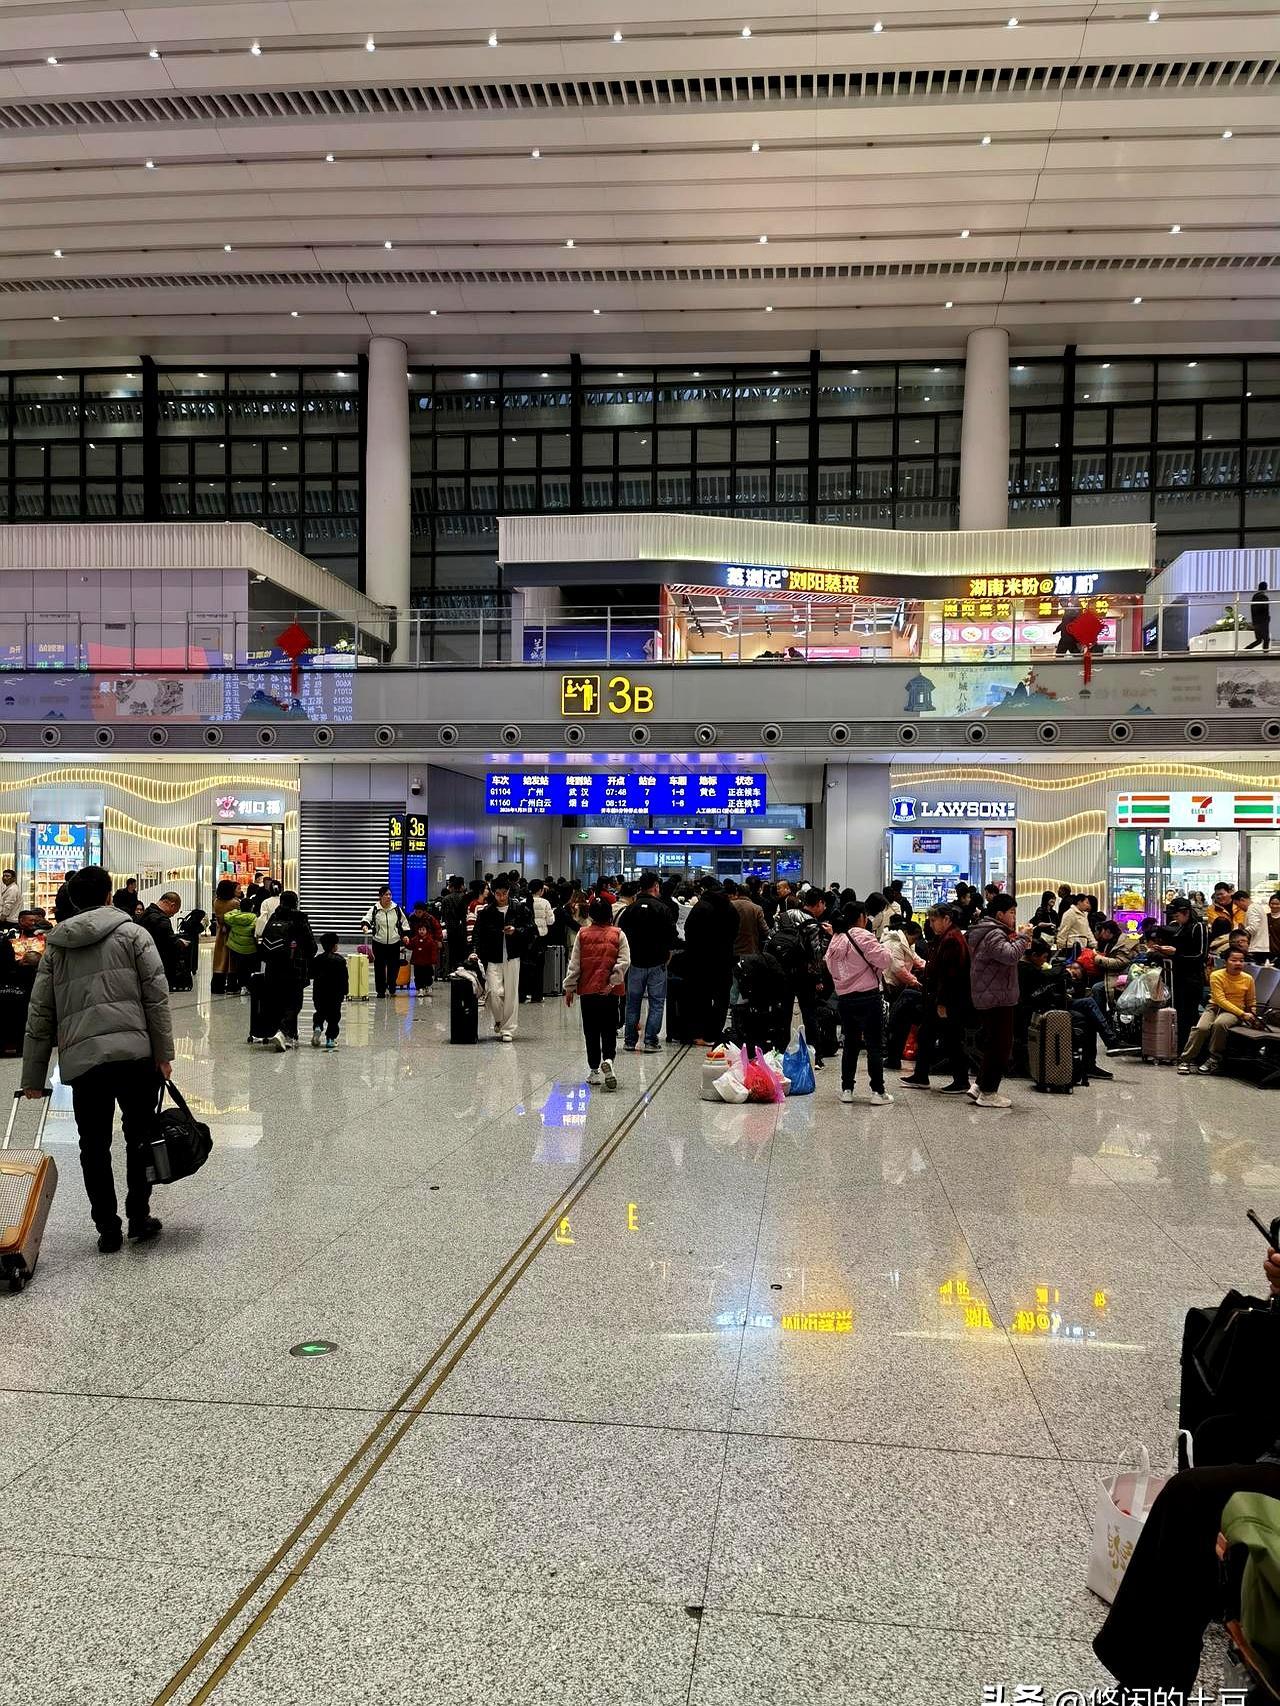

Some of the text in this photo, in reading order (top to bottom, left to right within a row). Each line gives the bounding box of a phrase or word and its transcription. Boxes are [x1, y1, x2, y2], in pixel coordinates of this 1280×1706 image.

[788, 571, 860, 593] 浏阳蒸菜
[608, 676, 654, 714] 3B
[492, 776, 510, 786] 车次
[523, 776, 549, 786] 始发站
[607, 776, 626, 786] 开点
[638, 776, 657, 786] 站台
[735, 776, 754, 786] 状态
[490, 788, 511, 796] G1104
[527, 788, 544, 796] 广州
[645, 788, 650, 796] 7
[700, 788, 717, 797] 黄色
[728, 788, 762, 797] 正在候车
[238, 800, 281, 814] 利口福
[490, 799, 511, 807] K1160
[520, 799, 552, 807] 广州白云
[728, 799, 761, 807] 正在候车
[410, 817, 425, 836] 3B
